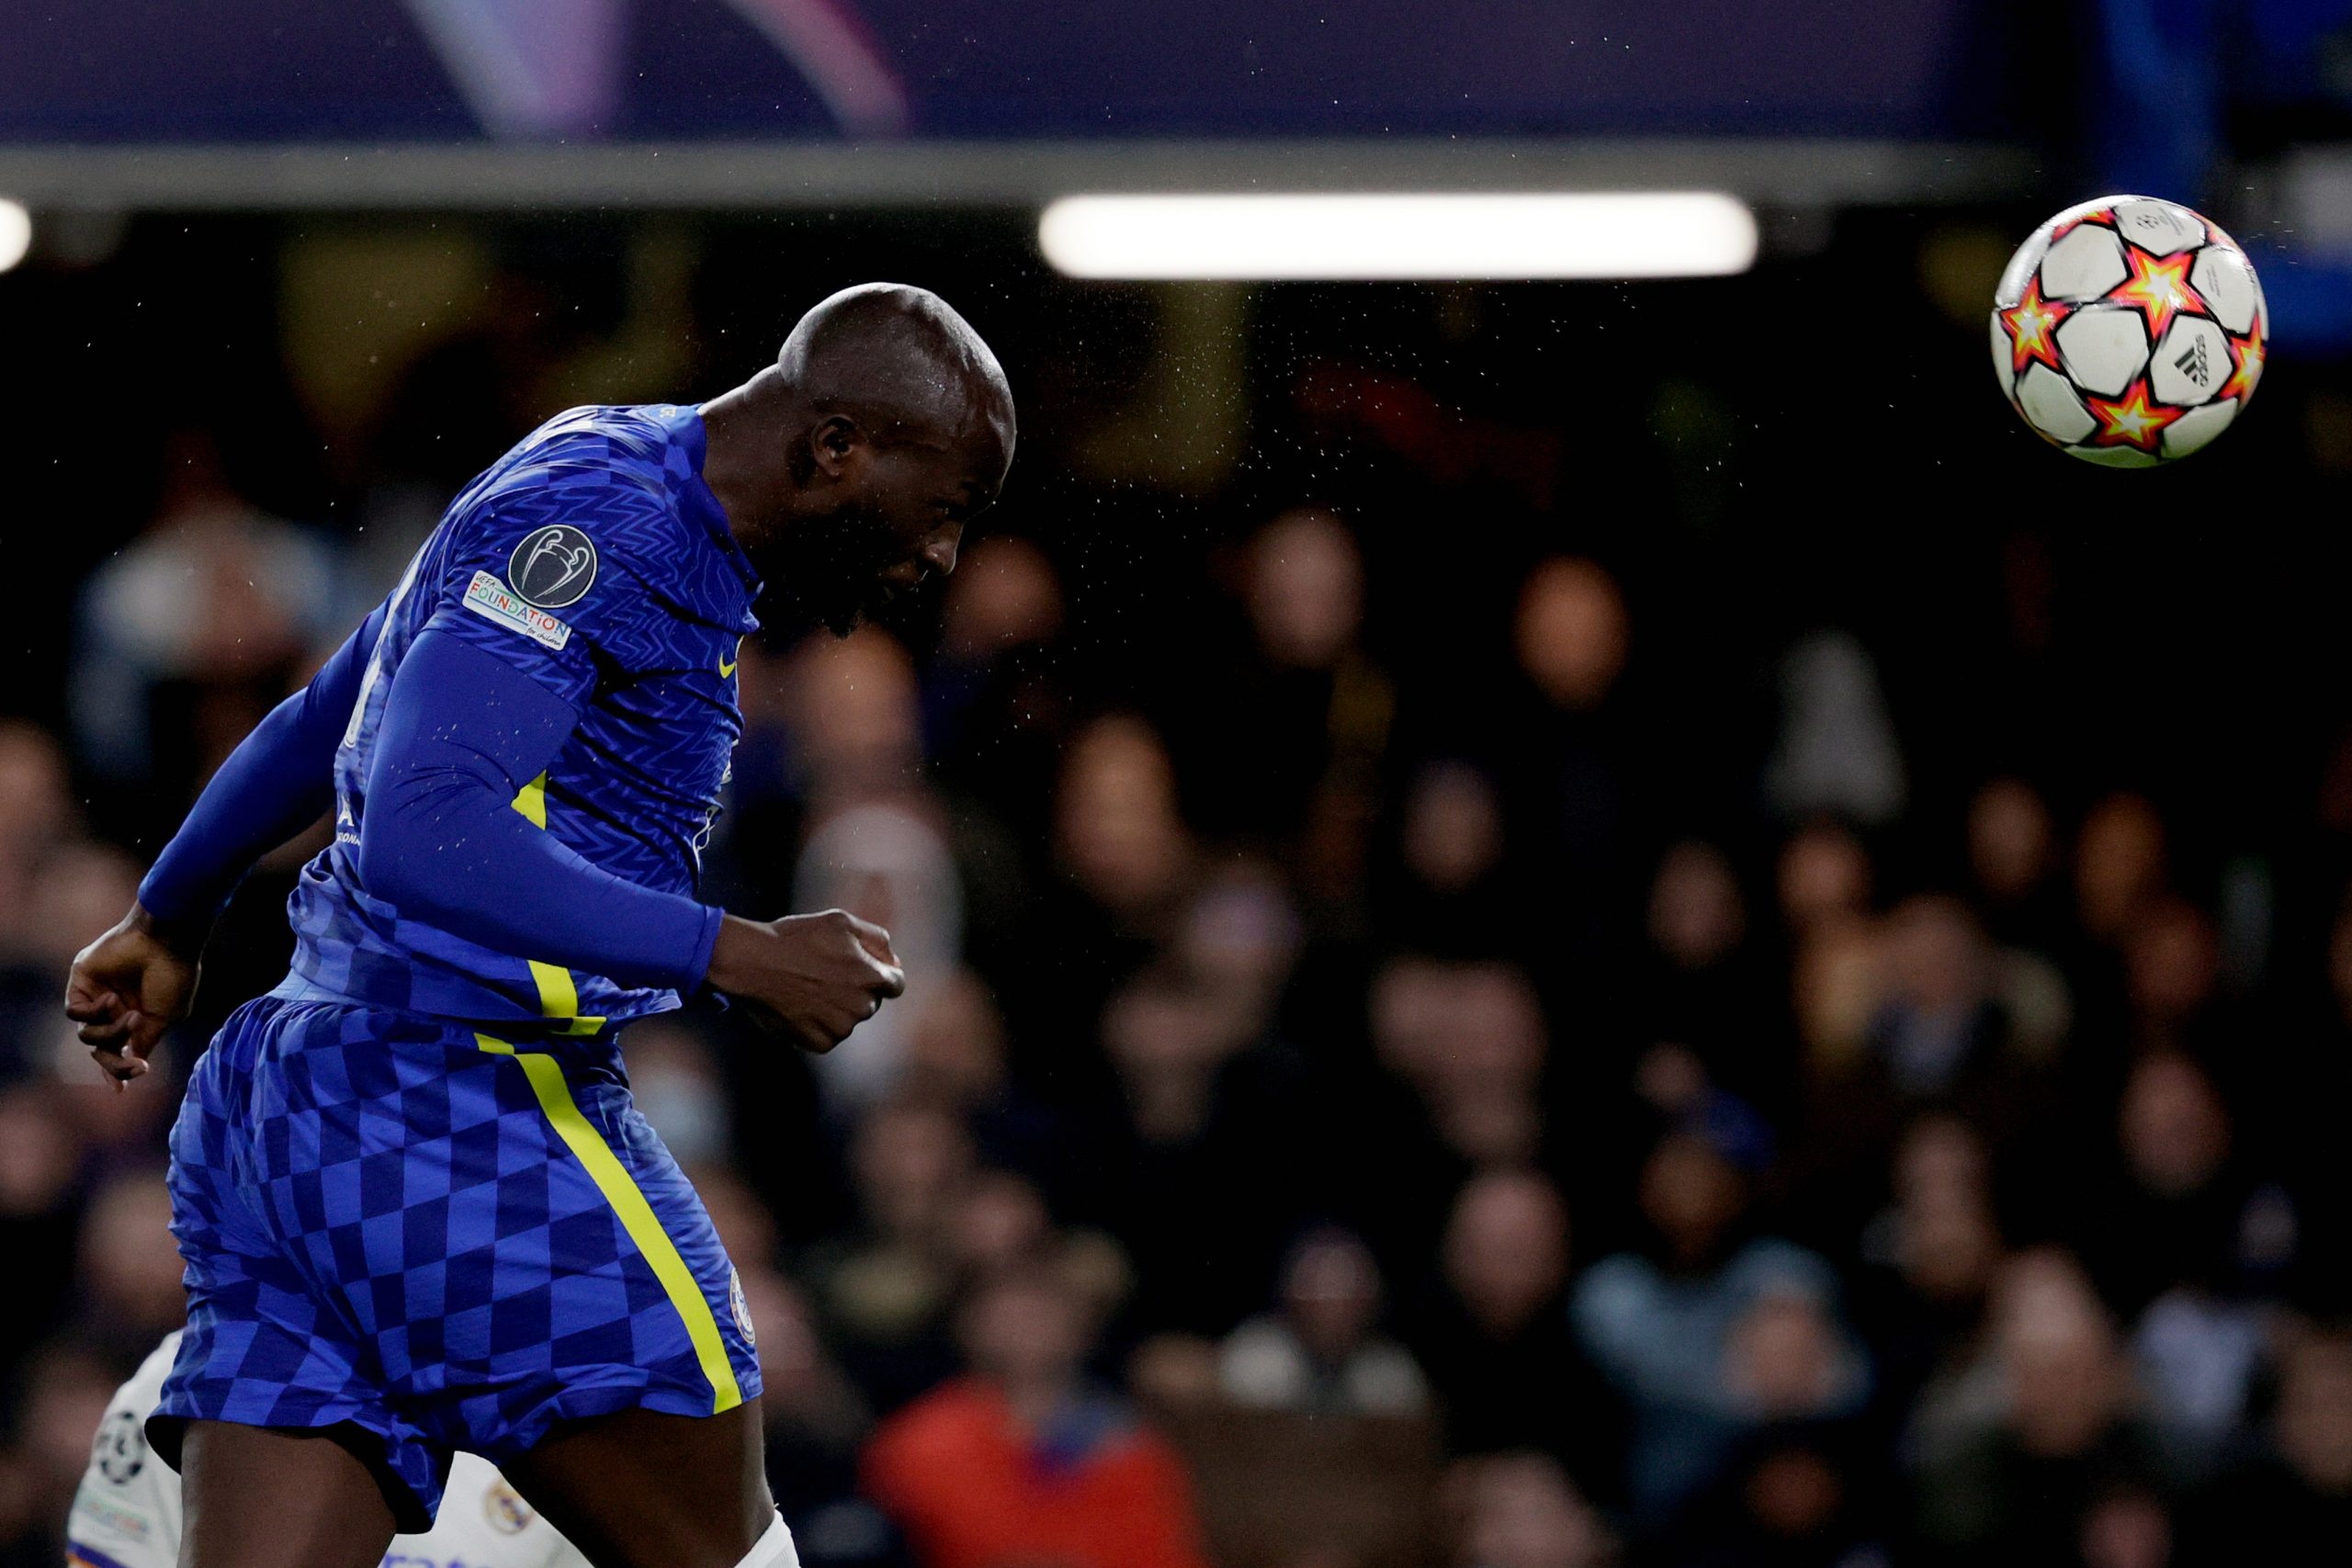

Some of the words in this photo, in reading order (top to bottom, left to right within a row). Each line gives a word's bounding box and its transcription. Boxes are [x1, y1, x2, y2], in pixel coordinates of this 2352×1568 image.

[2195, 333, 2209, 388] adidas
[475, 573, 497, 588] UEFA
[526, 626, 537, 635] for
[537, 632, 561, 646] children
